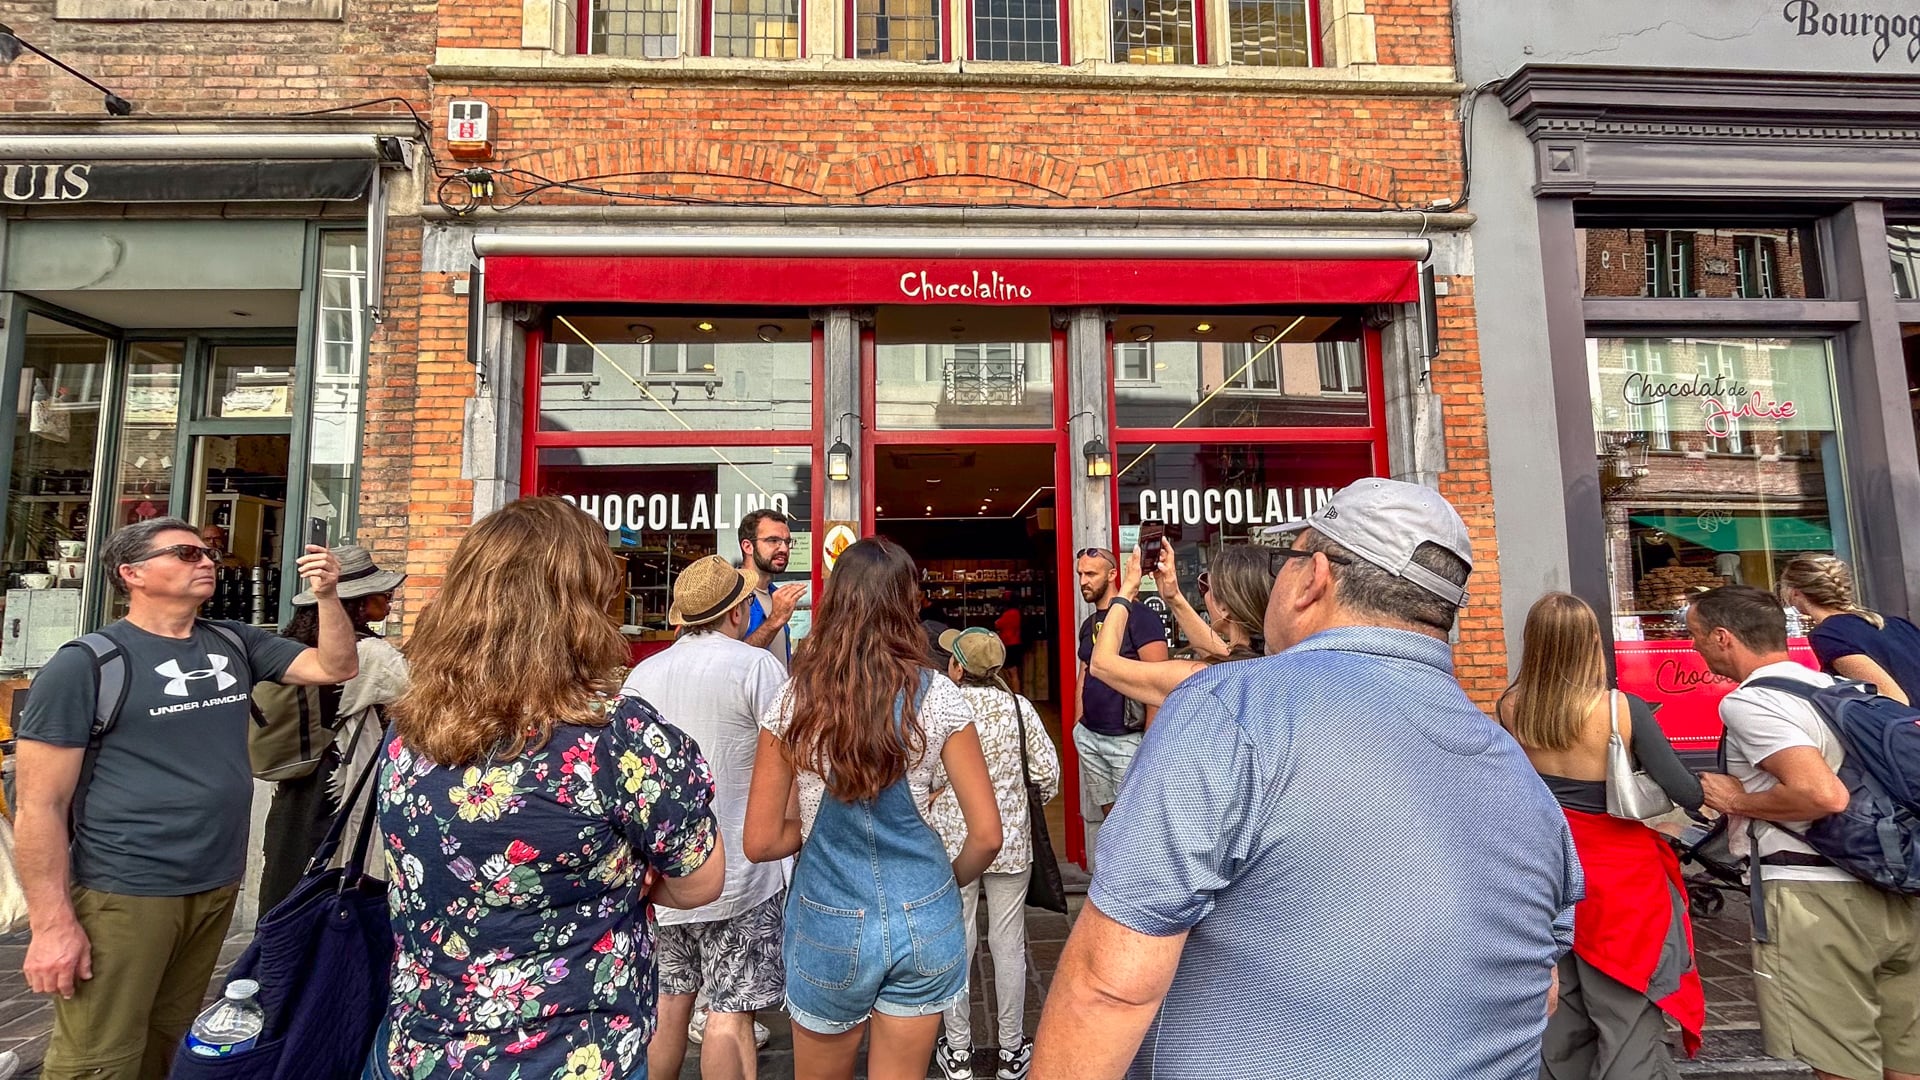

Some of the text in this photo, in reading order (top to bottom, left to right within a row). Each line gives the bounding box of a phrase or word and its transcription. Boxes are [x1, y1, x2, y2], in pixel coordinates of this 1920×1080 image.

[1783, 0, 1920, 63] Bourgog
[3, 164, 92, 200] UIS
[900, 270, 1032, 300] Chocolalino
[1623, 372, 1748, 406] Chocolat de
[1701, 391, 1798, 438] Julie
[561, 493, 789, 531] HOCOLALINO
[149, 693, 248, 716] UNDER ARMOUR
